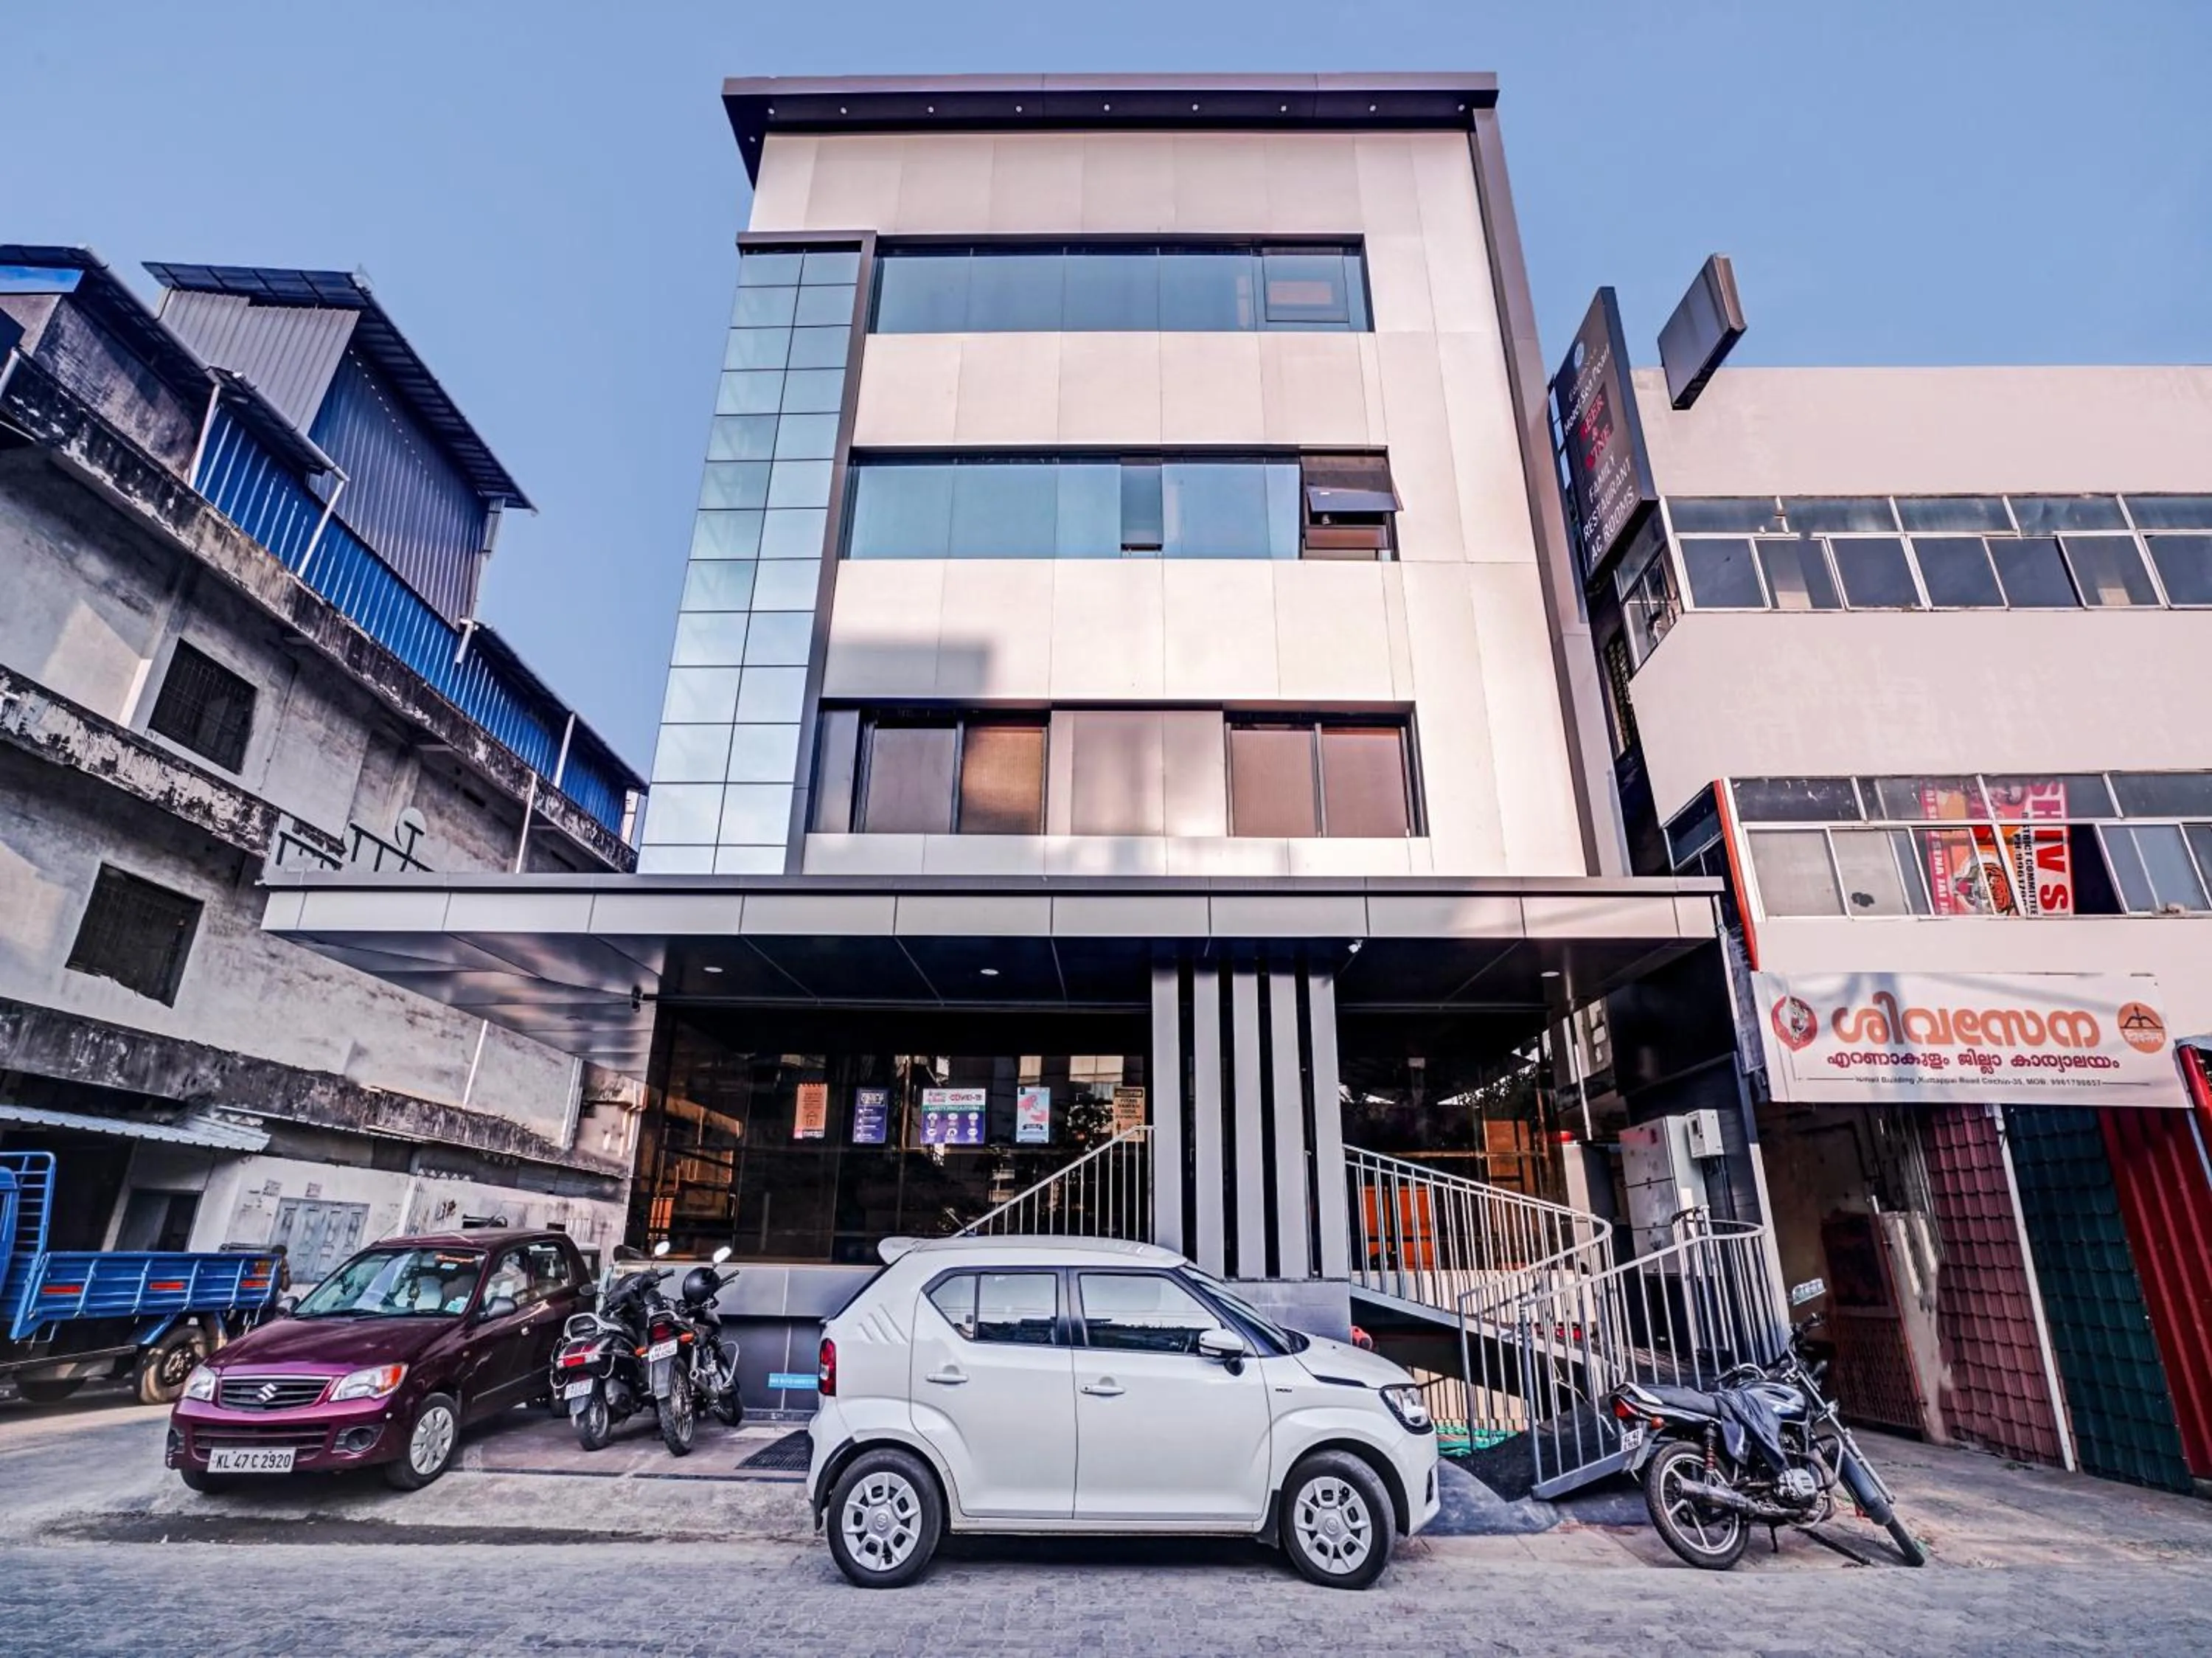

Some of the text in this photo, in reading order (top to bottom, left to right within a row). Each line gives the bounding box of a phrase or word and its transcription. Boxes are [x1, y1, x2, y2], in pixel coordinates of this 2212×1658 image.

[1583, 455, 1632, 542] RESTAURANT
[1588, 451, 1615, 504] FAMILY
[1591, 485, 1635, 563] AC ROOMS
[2025, 859, 2039, 915] COMMITTEE
[1831, 991, 2101, 1048] ശിവസേന
[1827, 1052, 1950, 1070] എറണാകുളം
[216, 1454, 291, 1468] KL 47 C 2920
